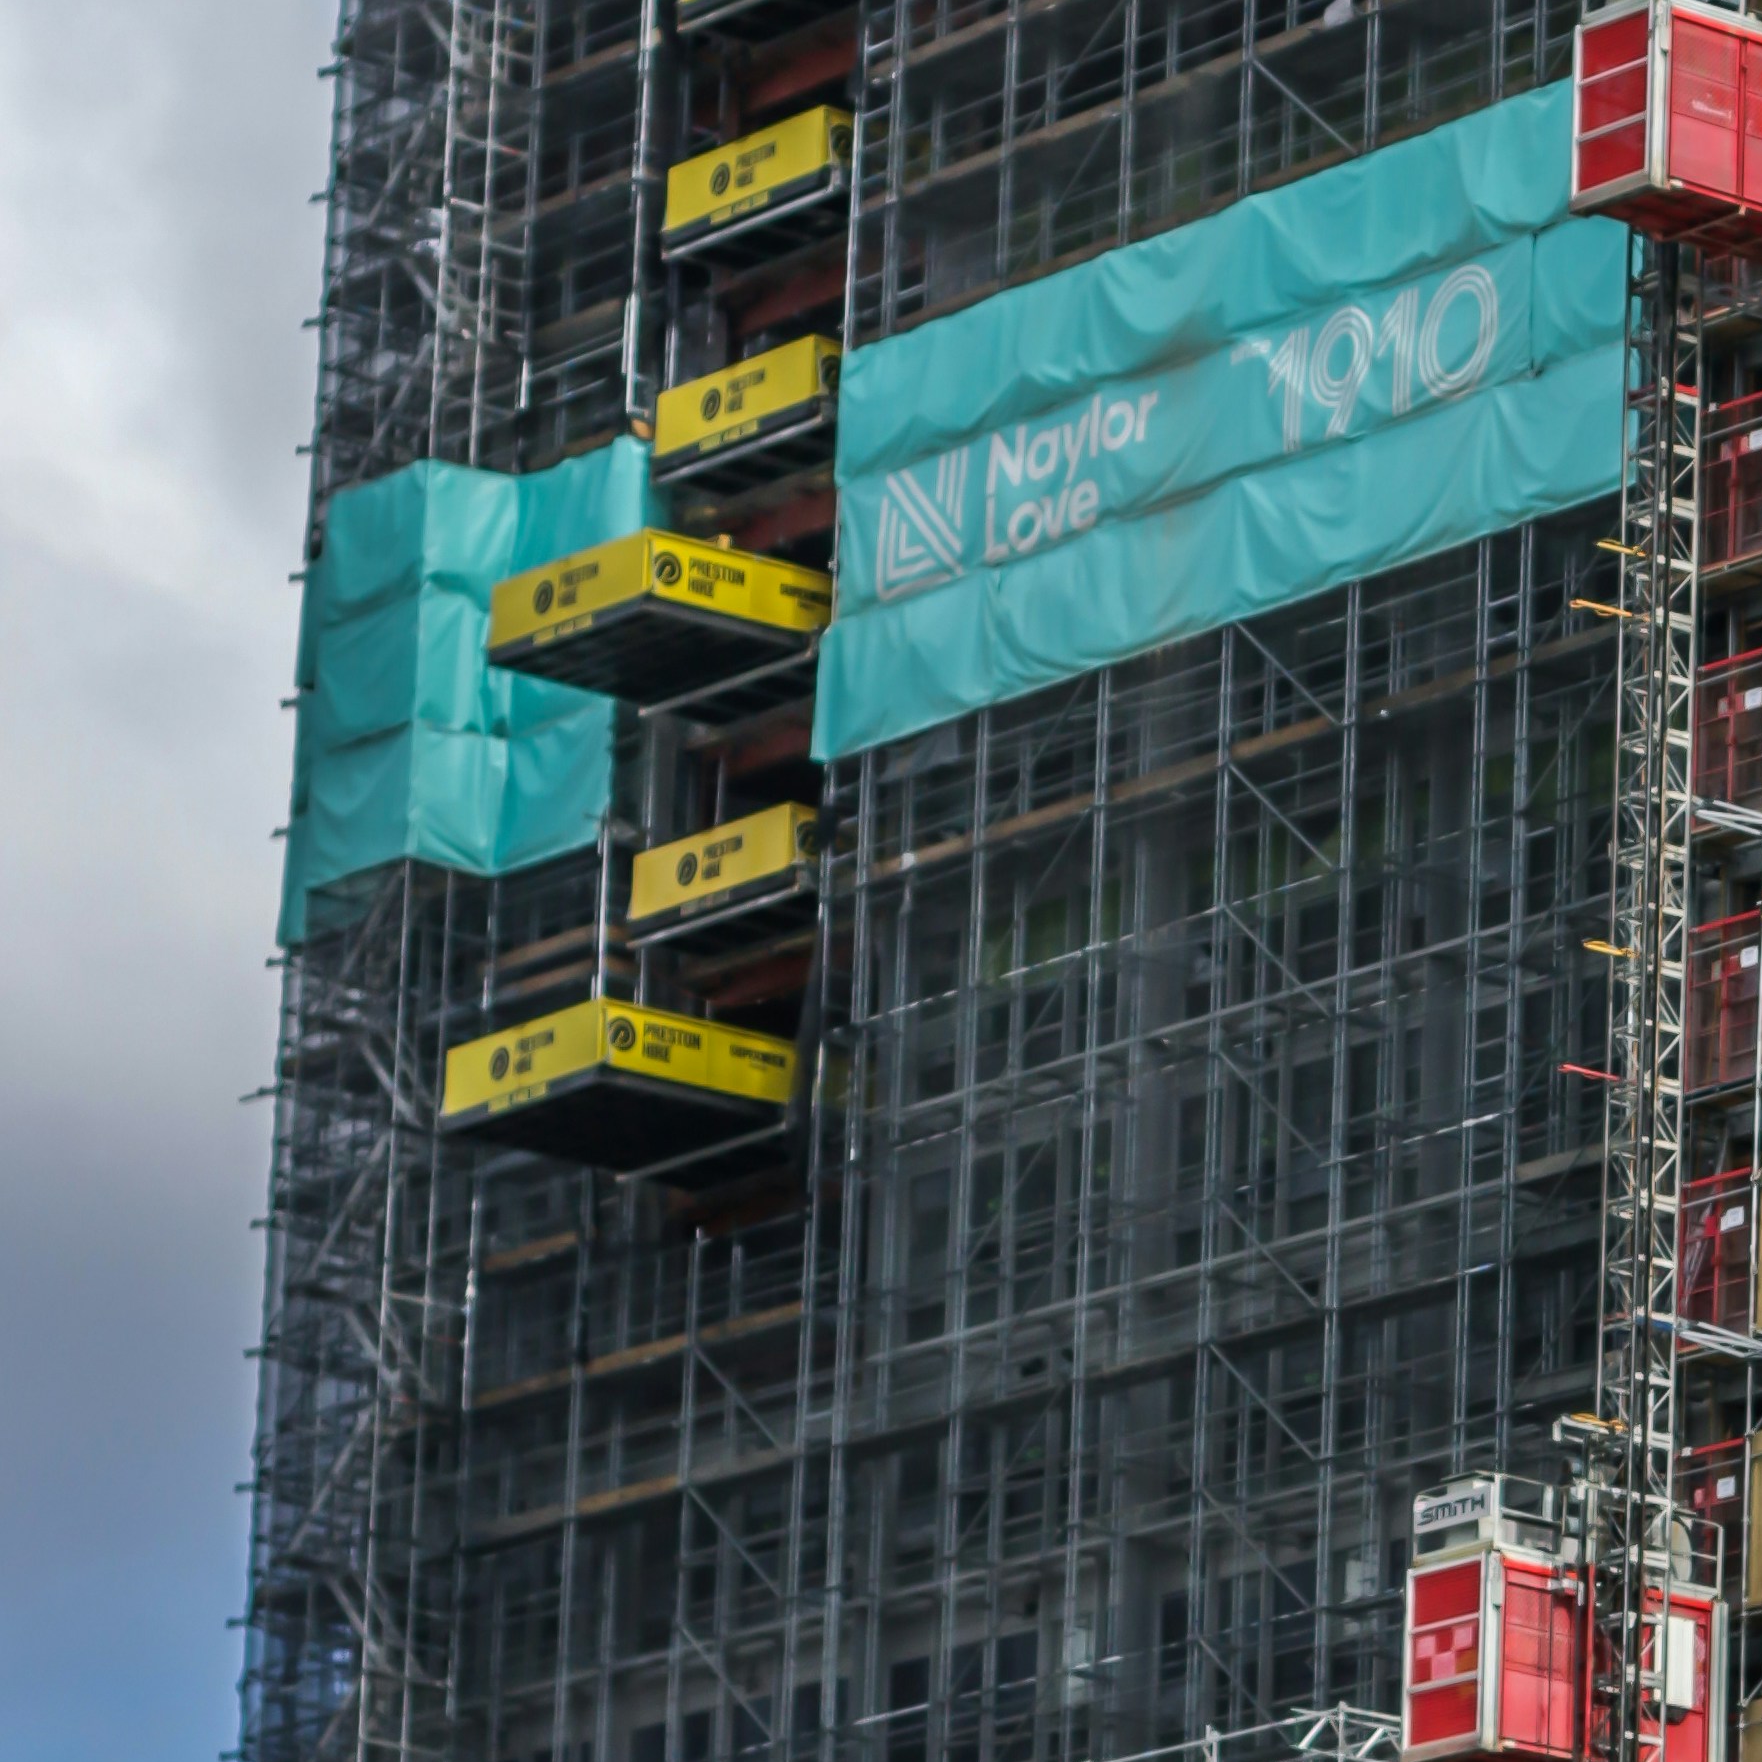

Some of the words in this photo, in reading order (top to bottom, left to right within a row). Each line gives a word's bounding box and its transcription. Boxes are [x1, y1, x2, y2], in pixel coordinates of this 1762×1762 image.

[1268, 264, 1499, 455] 1910
[986, 391, 1158, 494] Naylor
[985, 479, 1100, 565] Love
[688, 557, 746, 586] PRESTON
[643, 1020, 703, 1050] PRESTON
[1417, 1494, 1485, 1526] SMITH
